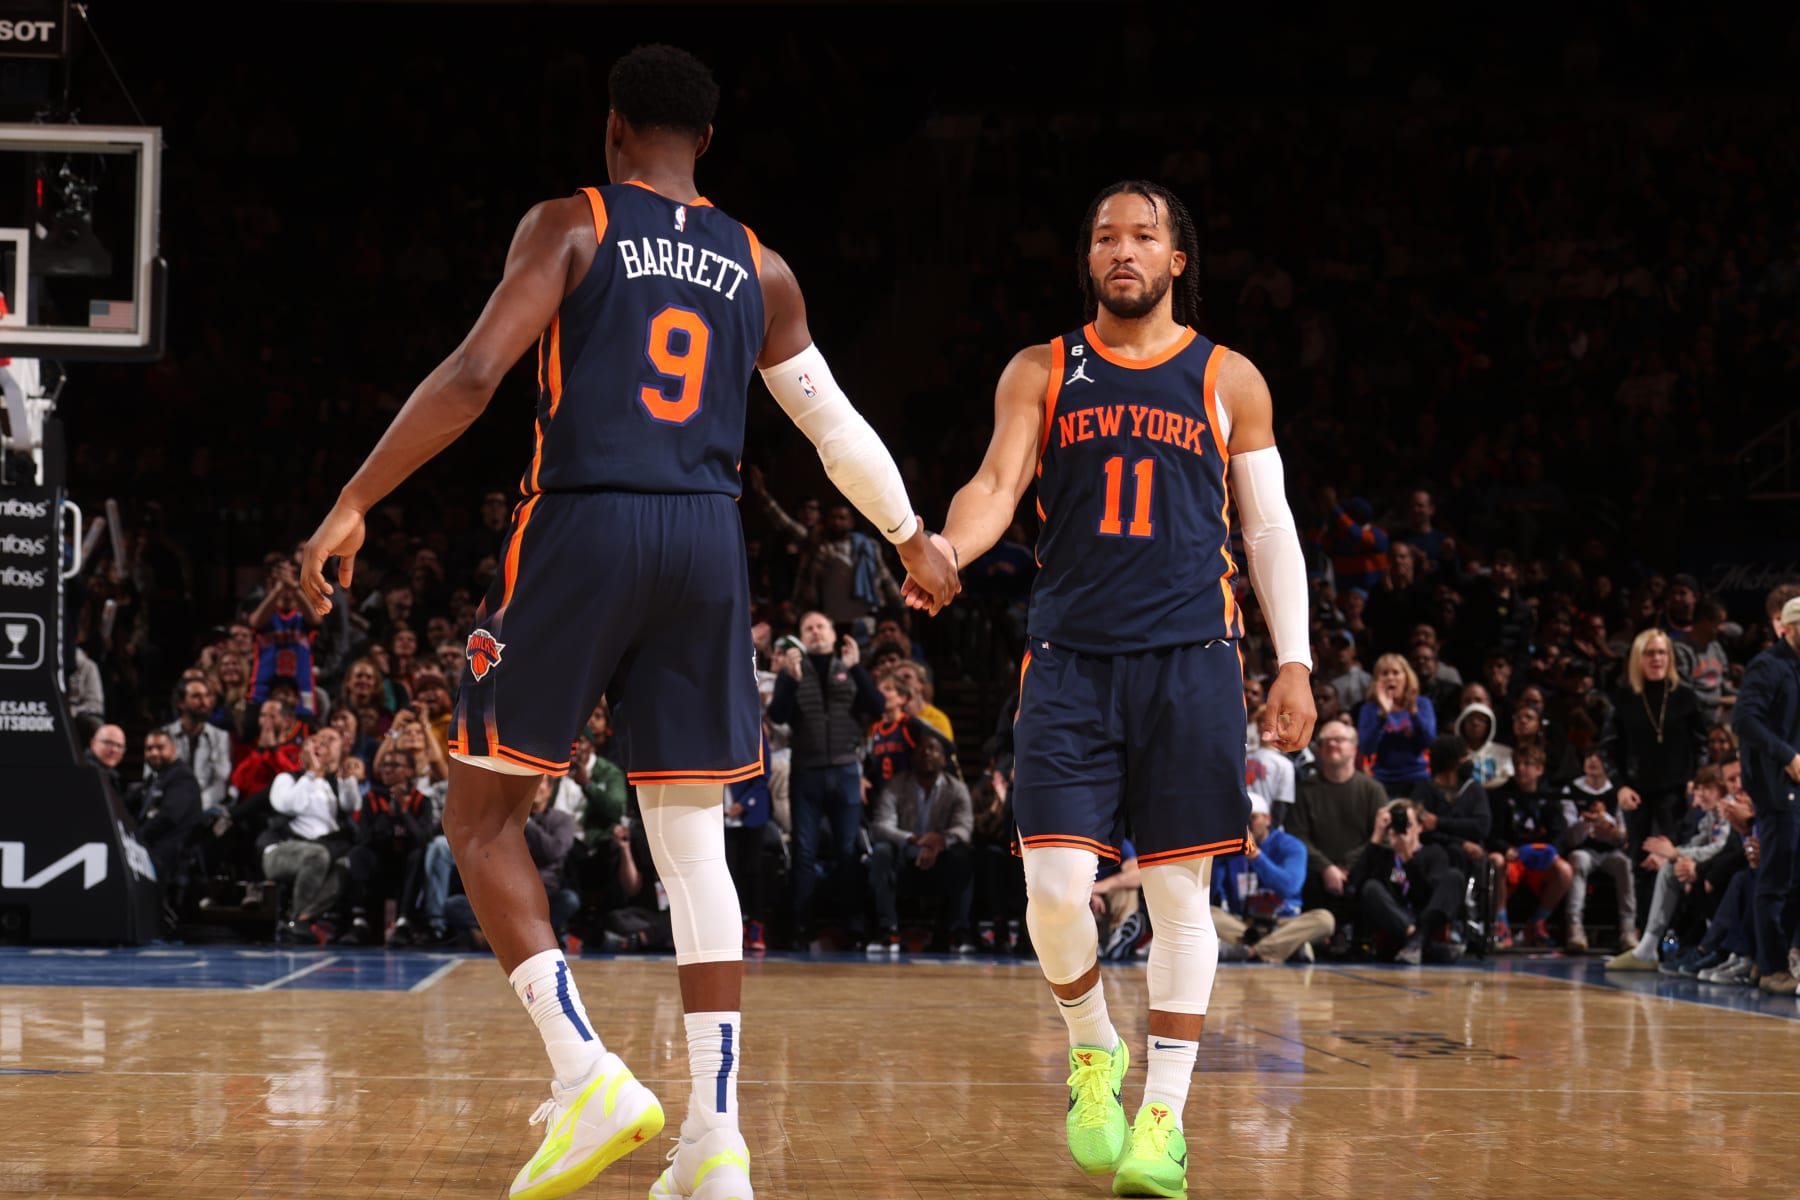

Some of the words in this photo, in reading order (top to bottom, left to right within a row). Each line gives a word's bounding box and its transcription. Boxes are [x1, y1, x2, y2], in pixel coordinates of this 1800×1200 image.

[0, 19, 56, 42] SOT
[617, 237, 748, 301] BARRETT
[637, 302, 713, 427] 9
[1071, 345, 1084, 356] 6
[1057, 404, 1126, 449] NEW
[1127, 404, 1207, 457] YORK
[1097, 453, 1157, 540] 11
